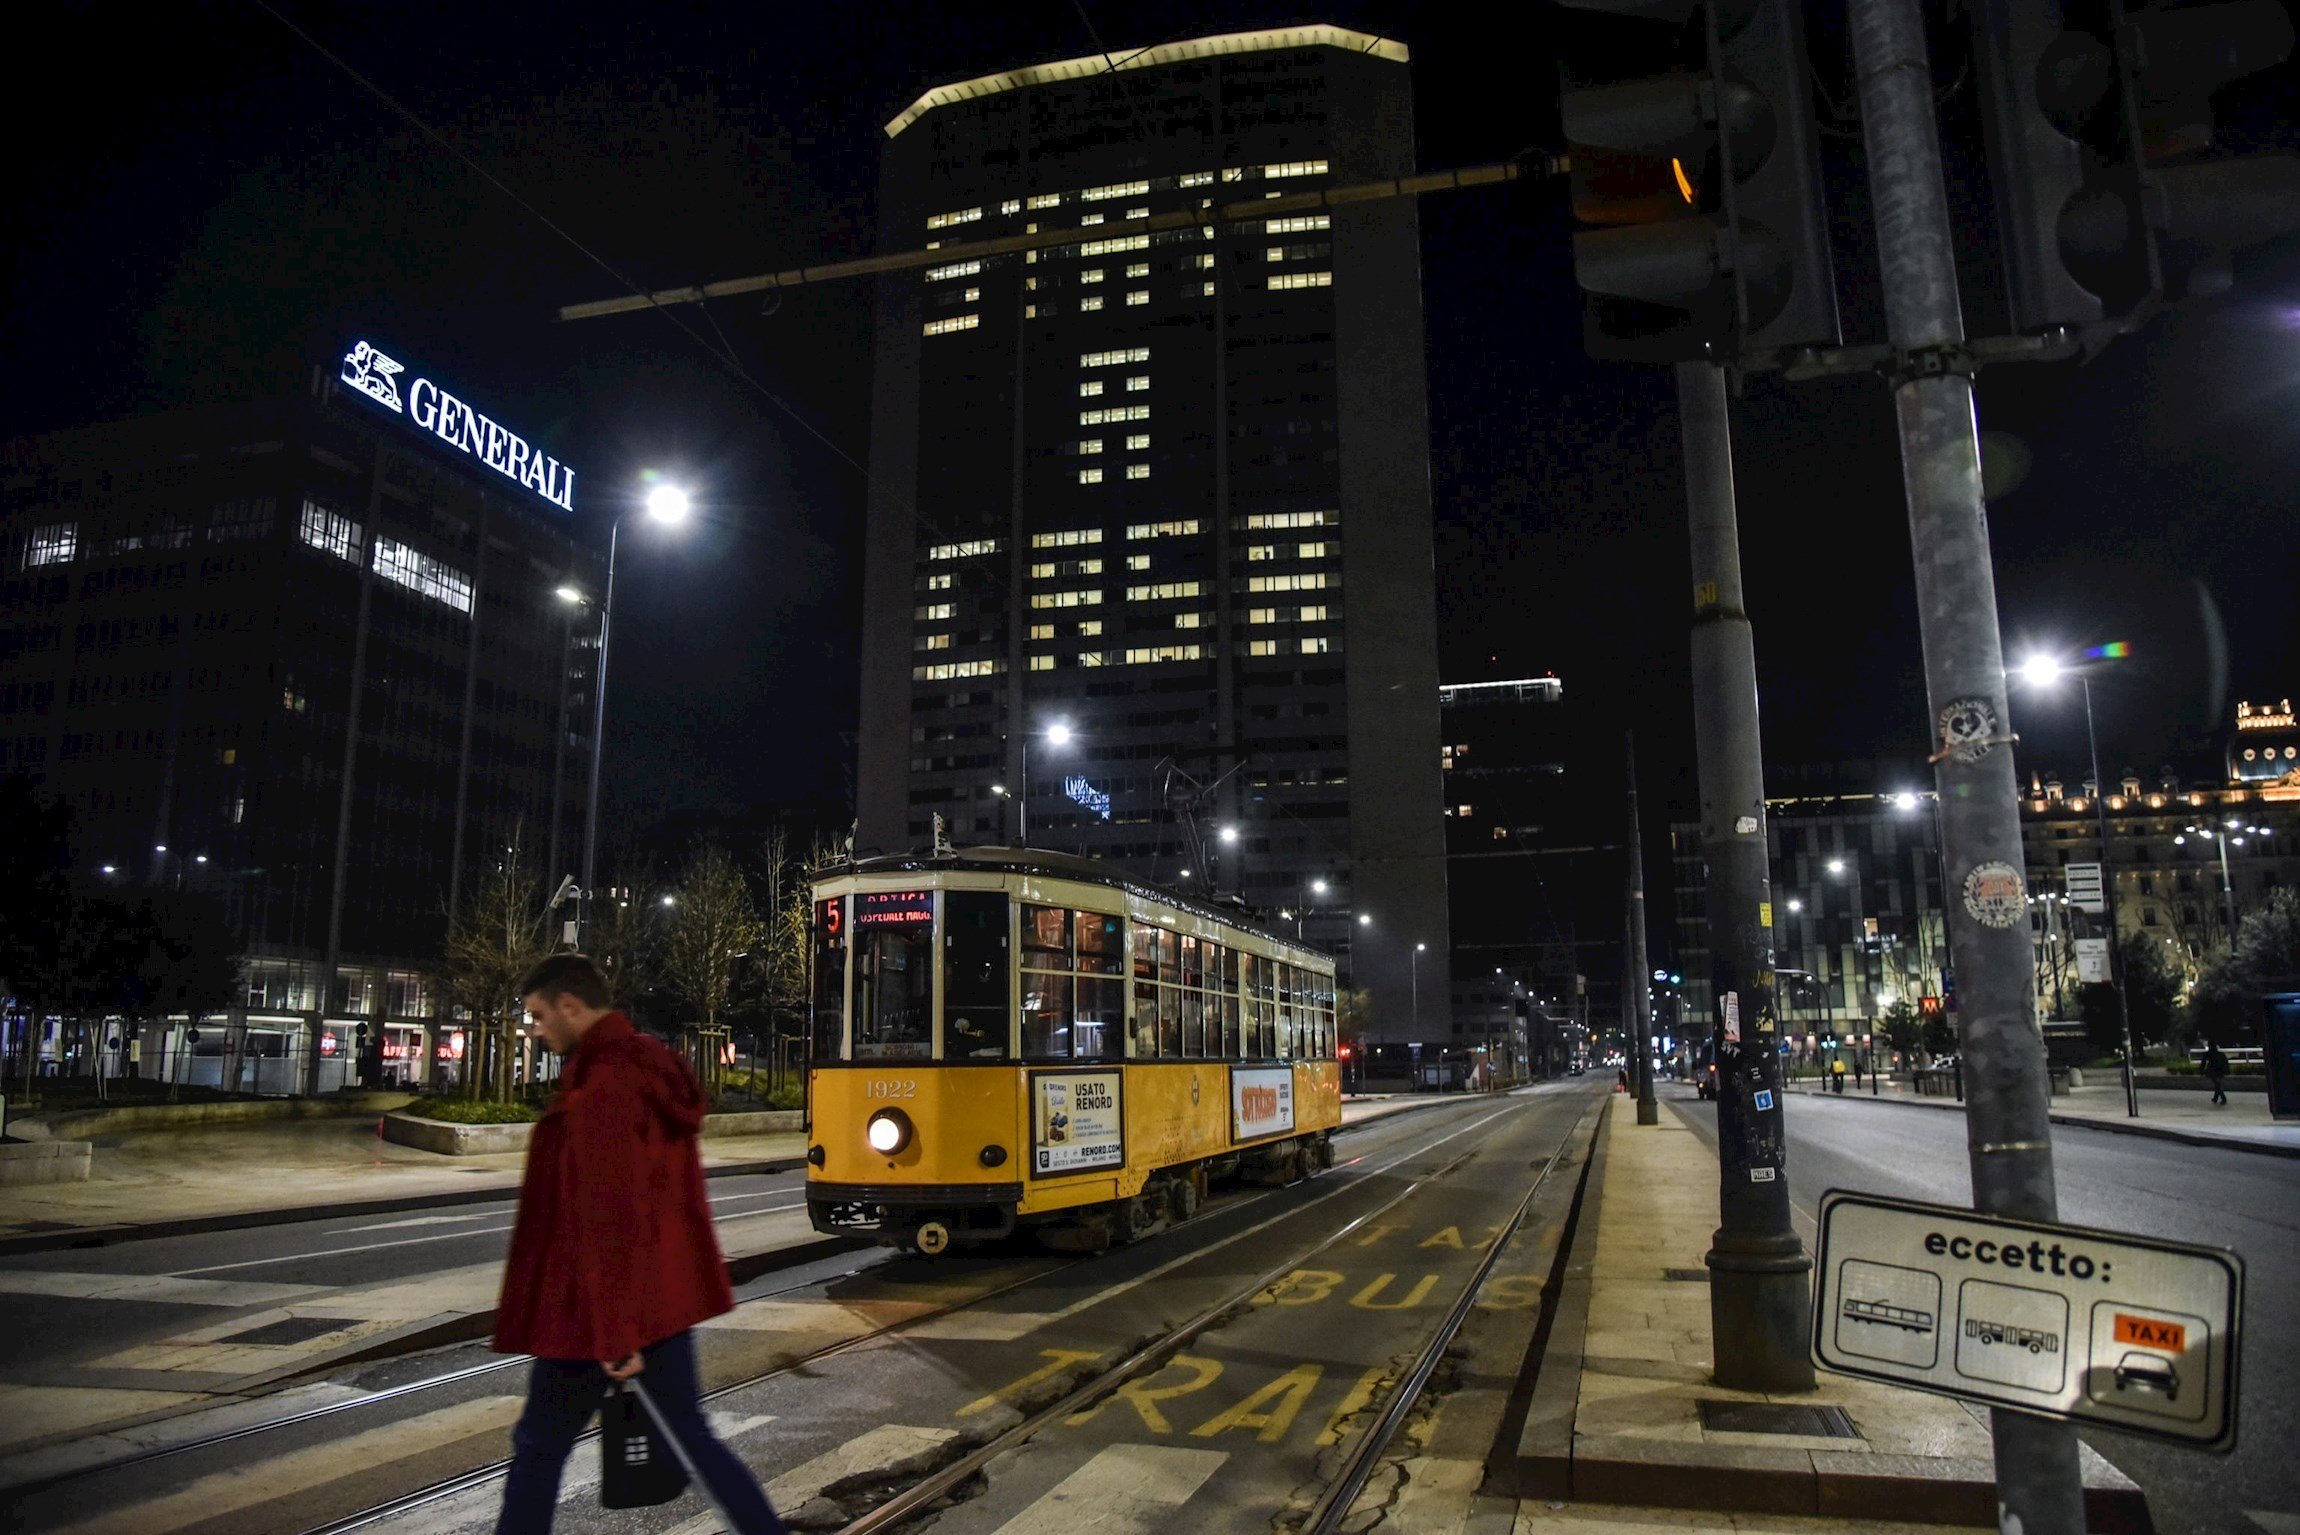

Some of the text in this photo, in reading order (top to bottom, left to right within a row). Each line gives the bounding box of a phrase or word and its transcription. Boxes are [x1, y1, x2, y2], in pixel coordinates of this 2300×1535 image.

[409, 377, 576, 512] GENERALI
[827, 900, 840, 932] 5
[865, 1079, 917, 1099] 1922
[1075, 1083, 1105, 1096] USATO
[1076, 1097, 1112, 1110] RENORD
[1081, 1144, 1121, 1156] RENORD.COM
[1924, 1231, 2112, 1283] eccetto:
[1246, 1269, 1549, 1310] BUS
[2128, 1322, 2179, 1346] TAXI
